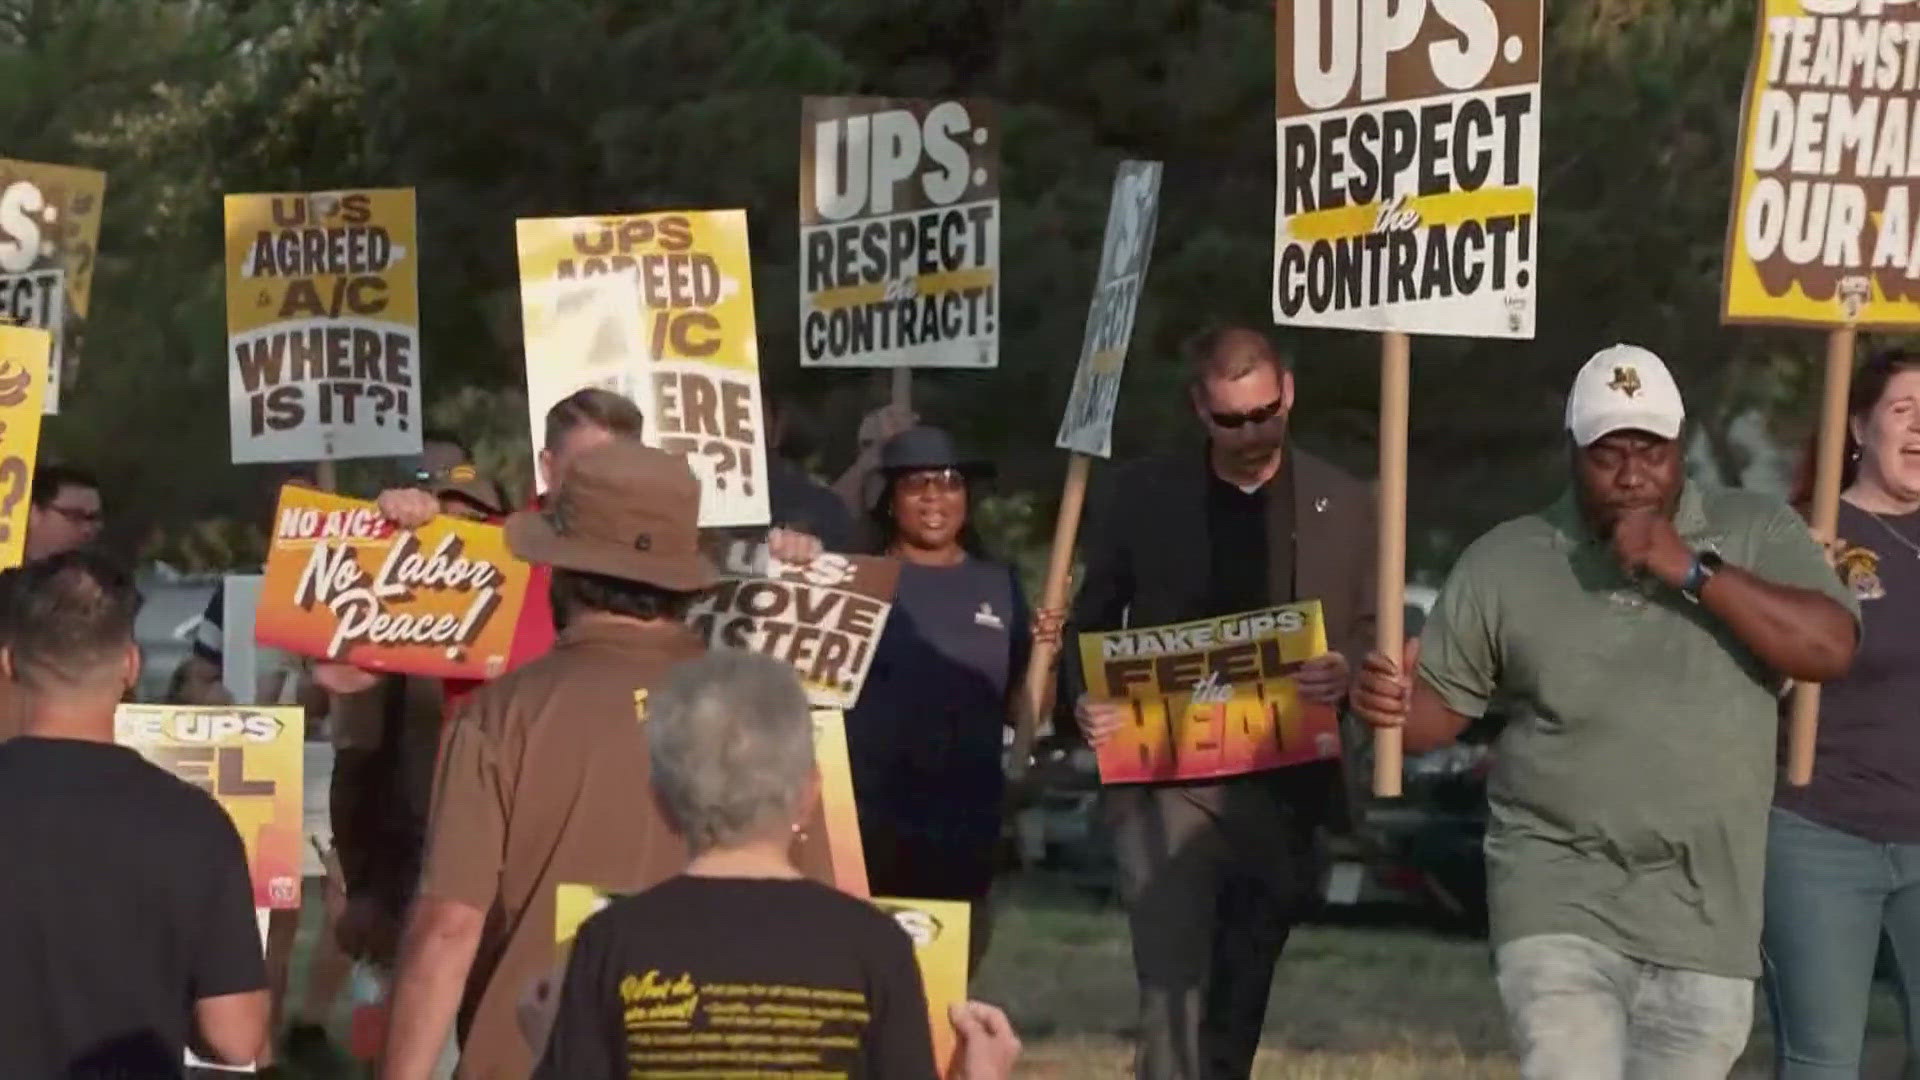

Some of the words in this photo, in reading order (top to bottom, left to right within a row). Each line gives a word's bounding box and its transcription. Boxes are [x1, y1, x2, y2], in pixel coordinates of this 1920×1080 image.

[815, 101, 988, 221] UPS:
[1284, 93, 1531, 216] RESPECT
[272, 193, 371, 228] UPS
[572, 216, 693, 255] UPS
[1374, 196, 1418, 233] the
[1744, 178, 1867, 267] OUR
[253, 226, 391, 277] AGREED
[807, 206, 993, 292] RESPECT
[1279, 213, 1532, 318] CONTRACT!
[278, 276, 390, 319] A/C
[557, 253, 721, 308] EED
[805, 284, 994, 361] CONTRACT!
[235, 328, 412, 393] WHERE
[250, 386, 305, 437] IS
[318, 382, 408, 432] IT?!
[652, 372, 755, 445] ERE
[279, 508, 319, 537] NO
[294, 540, 362, 606] No
[373, 530, 497, 597] Labor
[327, 585, 496, 659] Peace!
[1103, 630, 1216, 657] MAKE
[1221, 611, 1306, 646] UPS
[688, 614, 868, 692] ASTER!
[1104, 638, 1304, 698] FEEL
[1191, 671, 1234, 704] the
[173, 711, 278, 742] UPS
